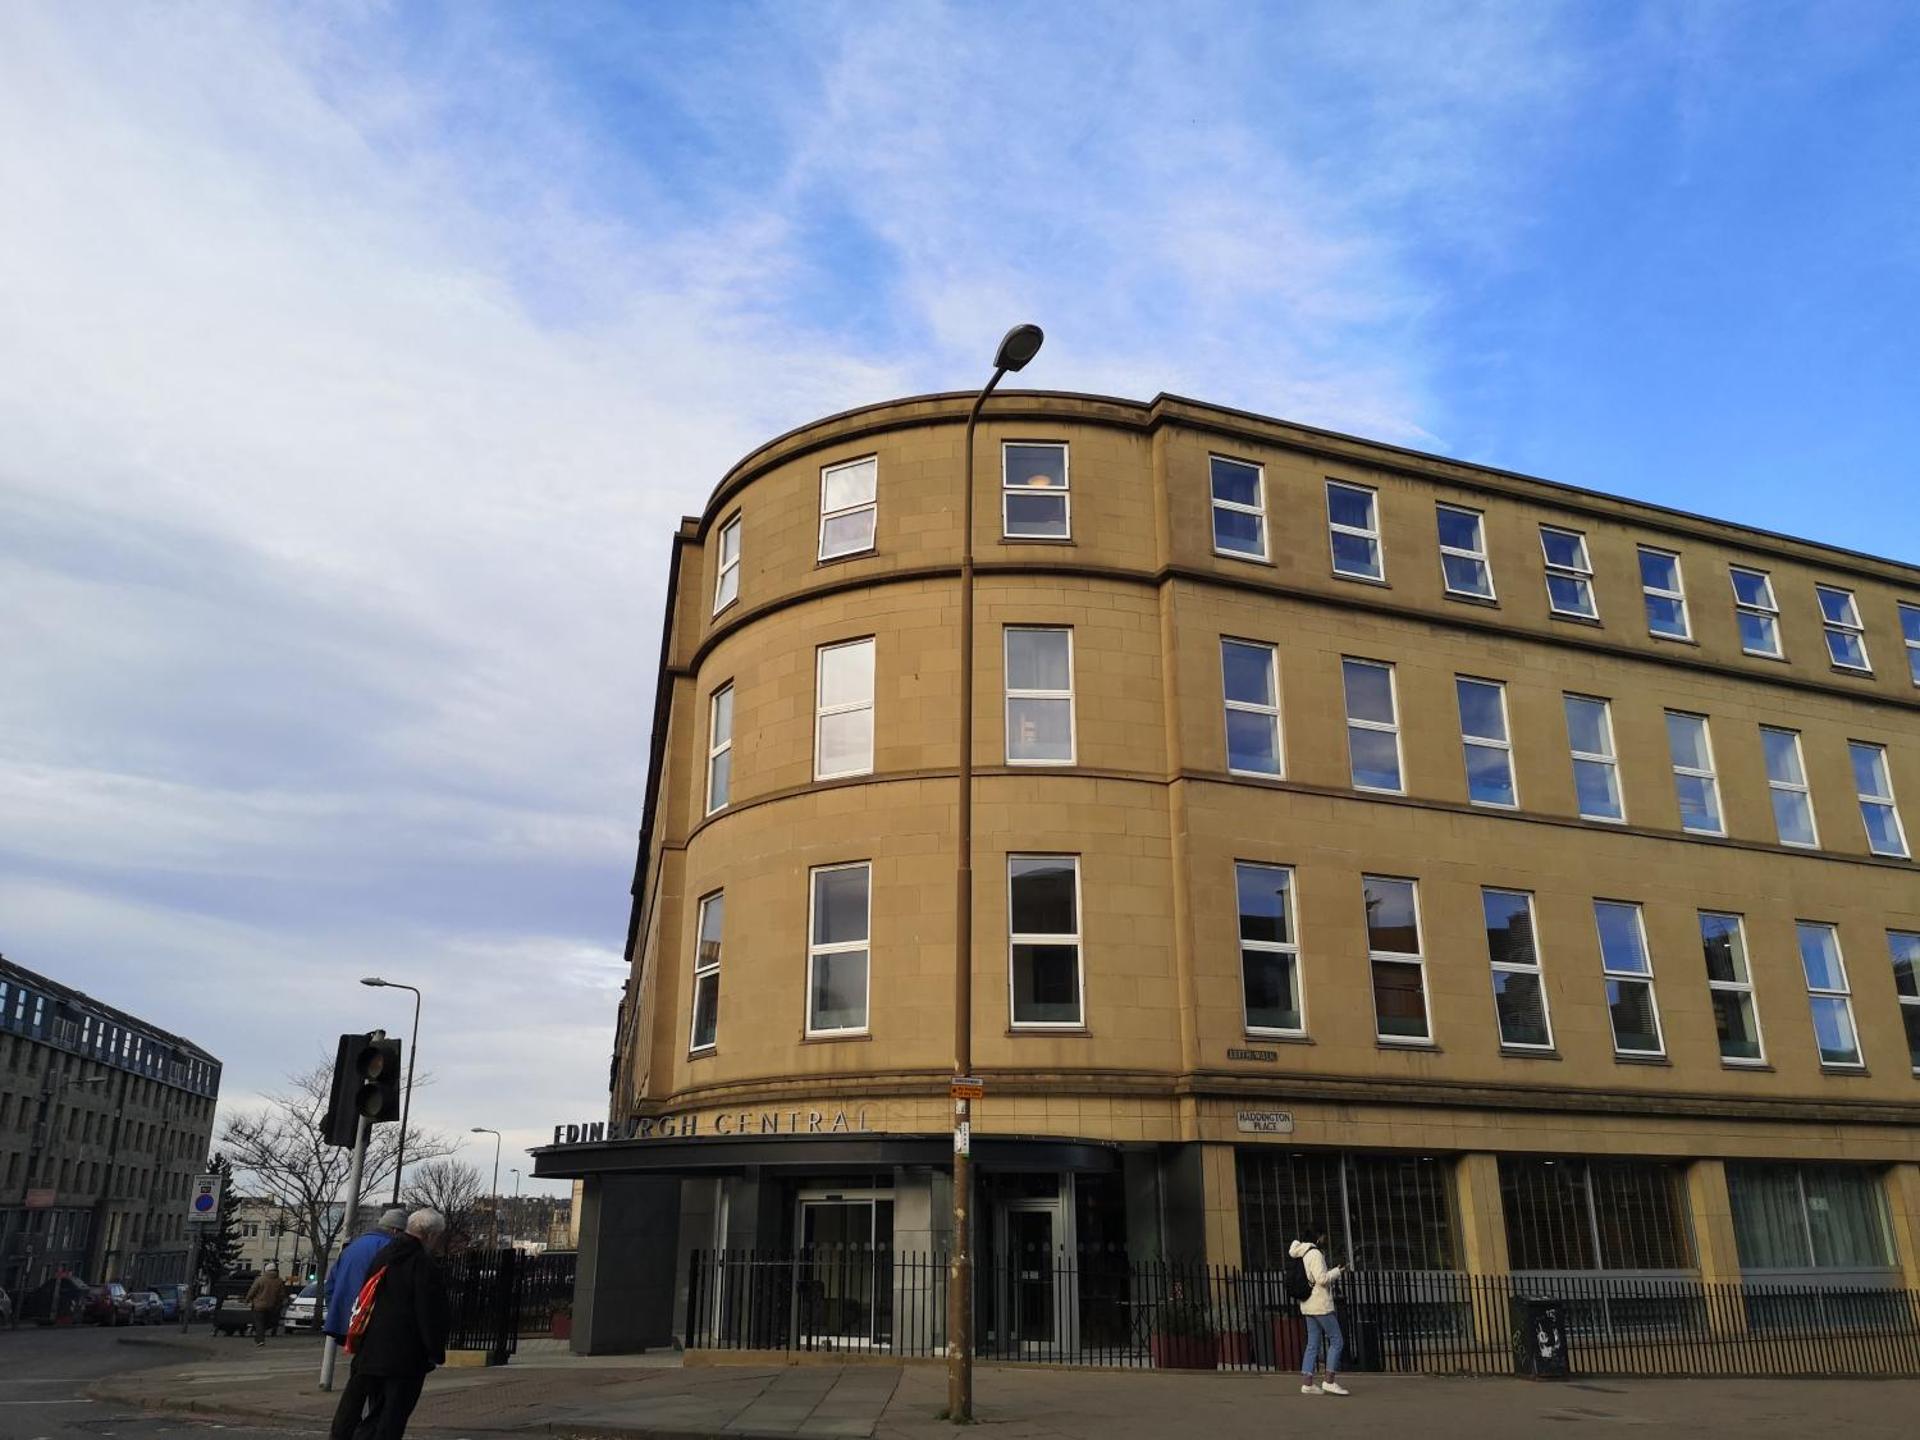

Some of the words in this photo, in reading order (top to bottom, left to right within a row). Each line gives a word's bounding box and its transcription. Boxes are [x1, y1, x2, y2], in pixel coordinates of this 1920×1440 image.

[1240, 1112, 1290, 1121] HADDINGTON
[554, 1115, 697, 1144] EDINBURGH
[714, 1109, 874, 1134] CENTRAL
[1254, 1121, 1277, 1130] PLACE
